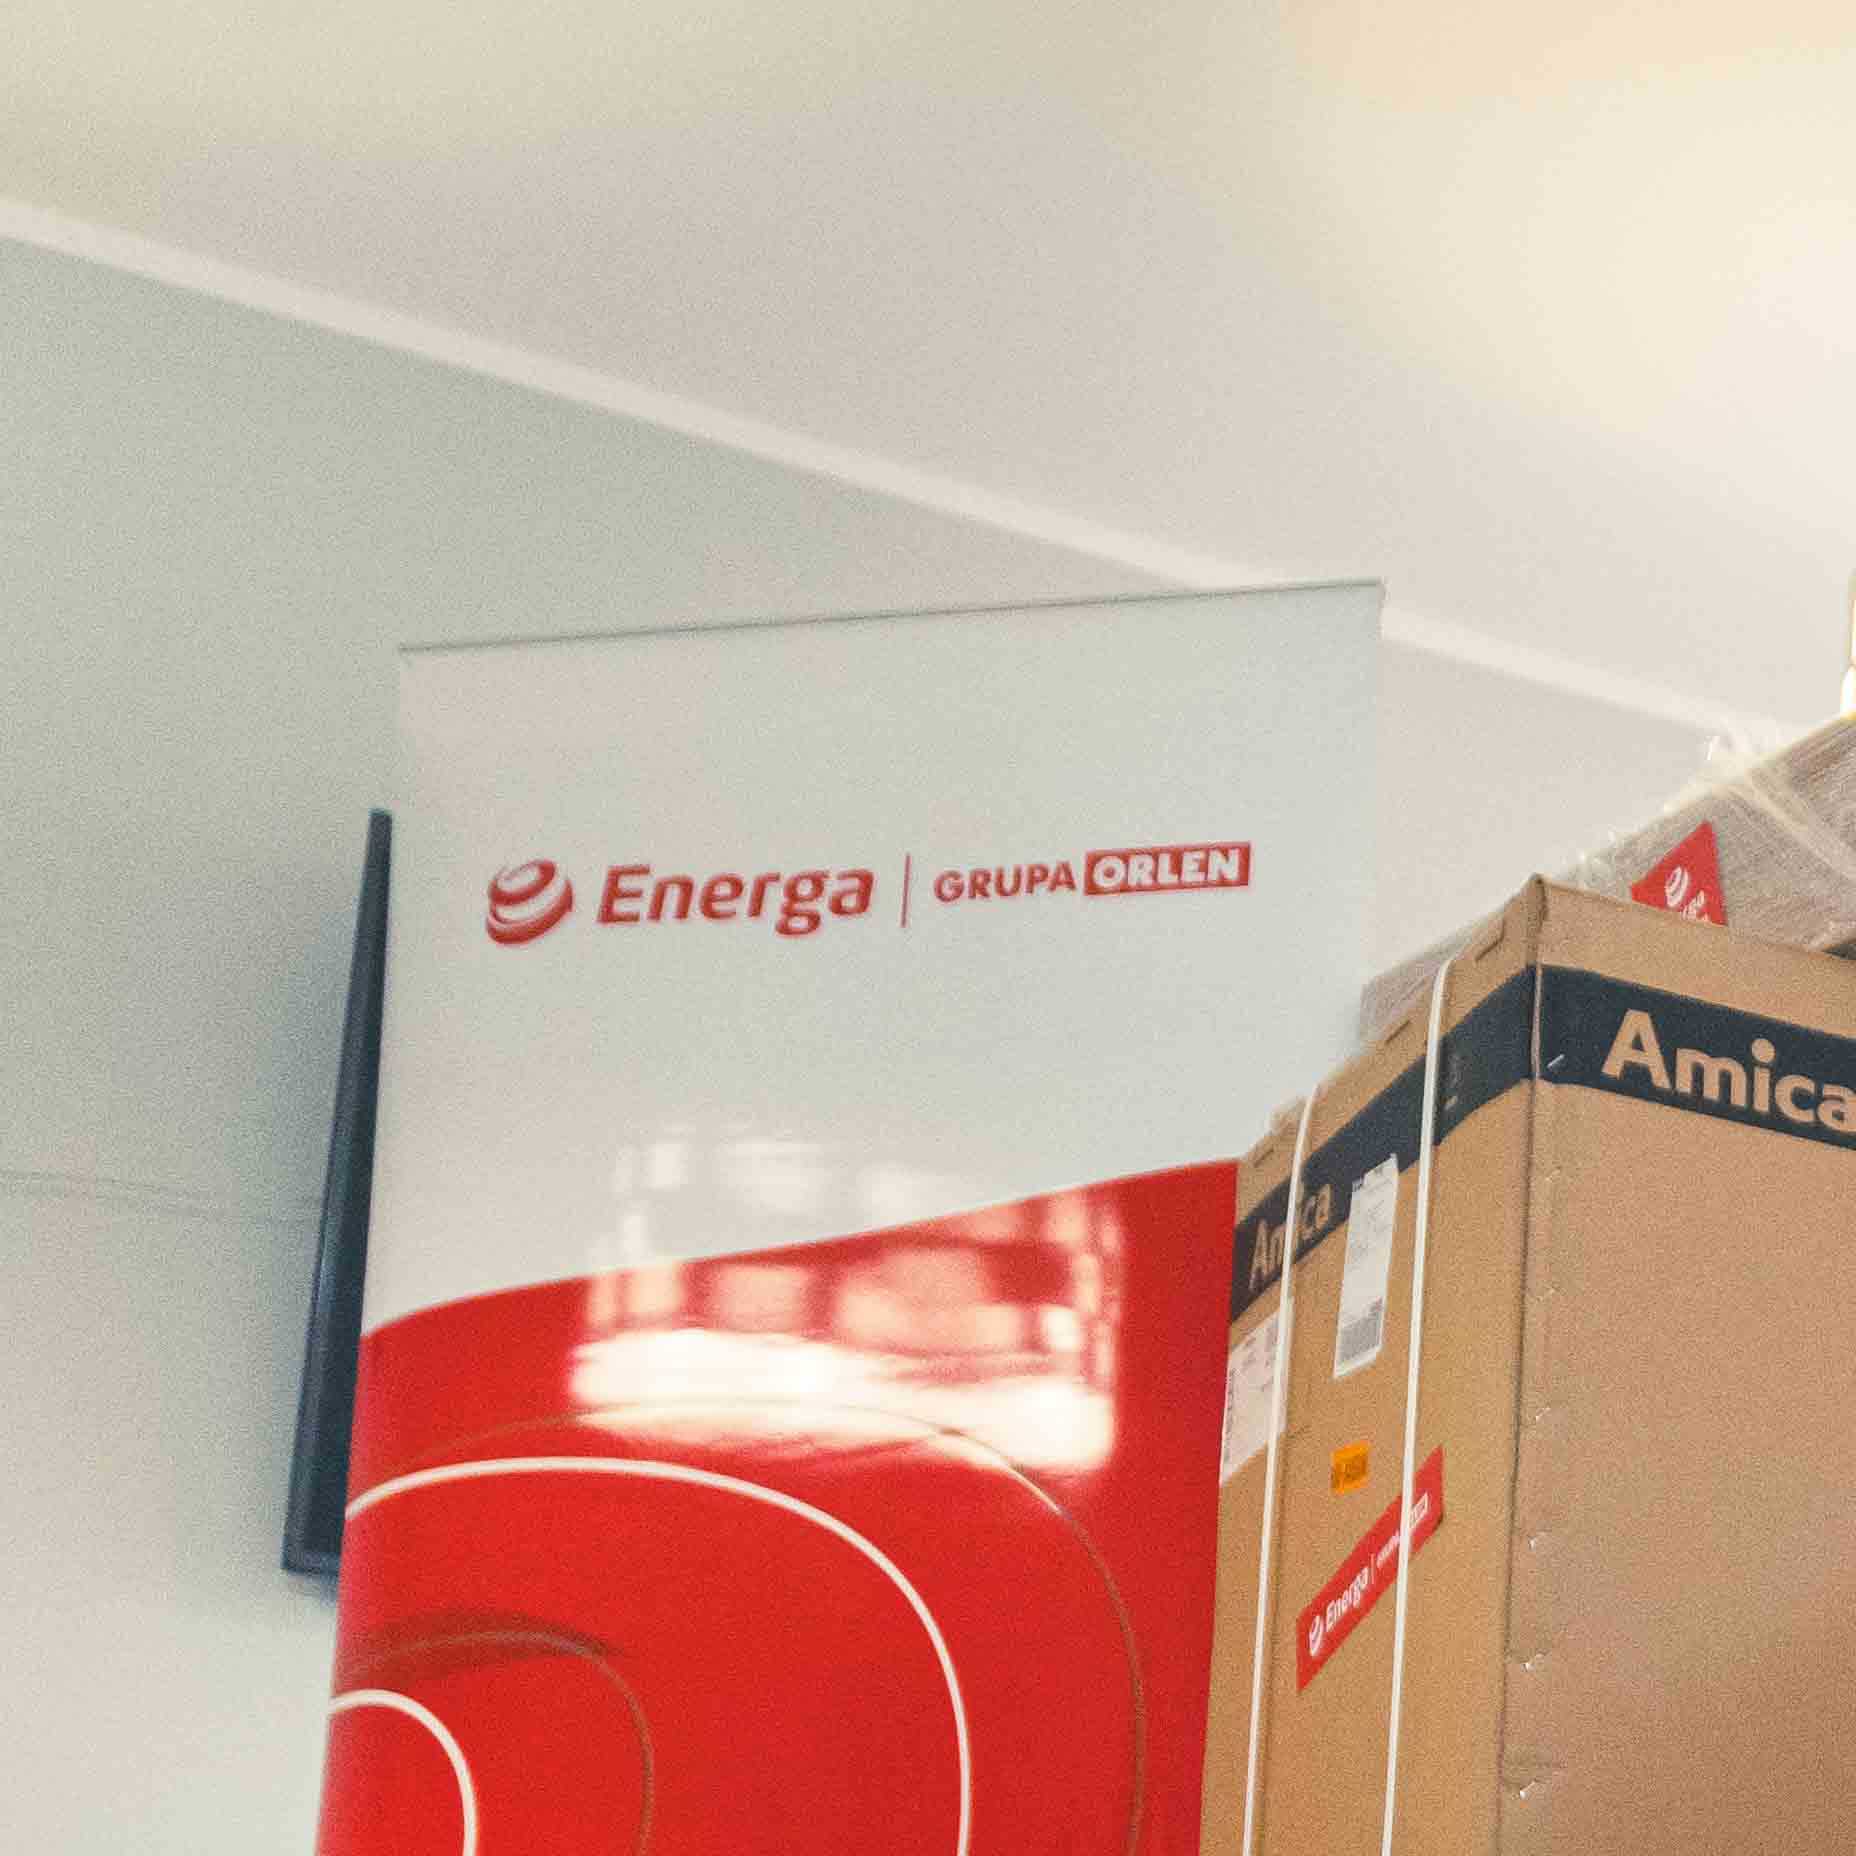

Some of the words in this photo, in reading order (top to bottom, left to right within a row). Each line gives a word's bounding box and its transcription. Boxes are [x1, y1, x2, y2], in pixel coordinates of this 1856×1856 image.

[598, 864, 874, 937] Energa
[934, 864, 1077, 905] GRUPA
[1092, 846, 1243, 890] ORLEN
[1250, 1183, 1332, 1293] Amca
[1325, 1566, 1369, 1633] Energa
